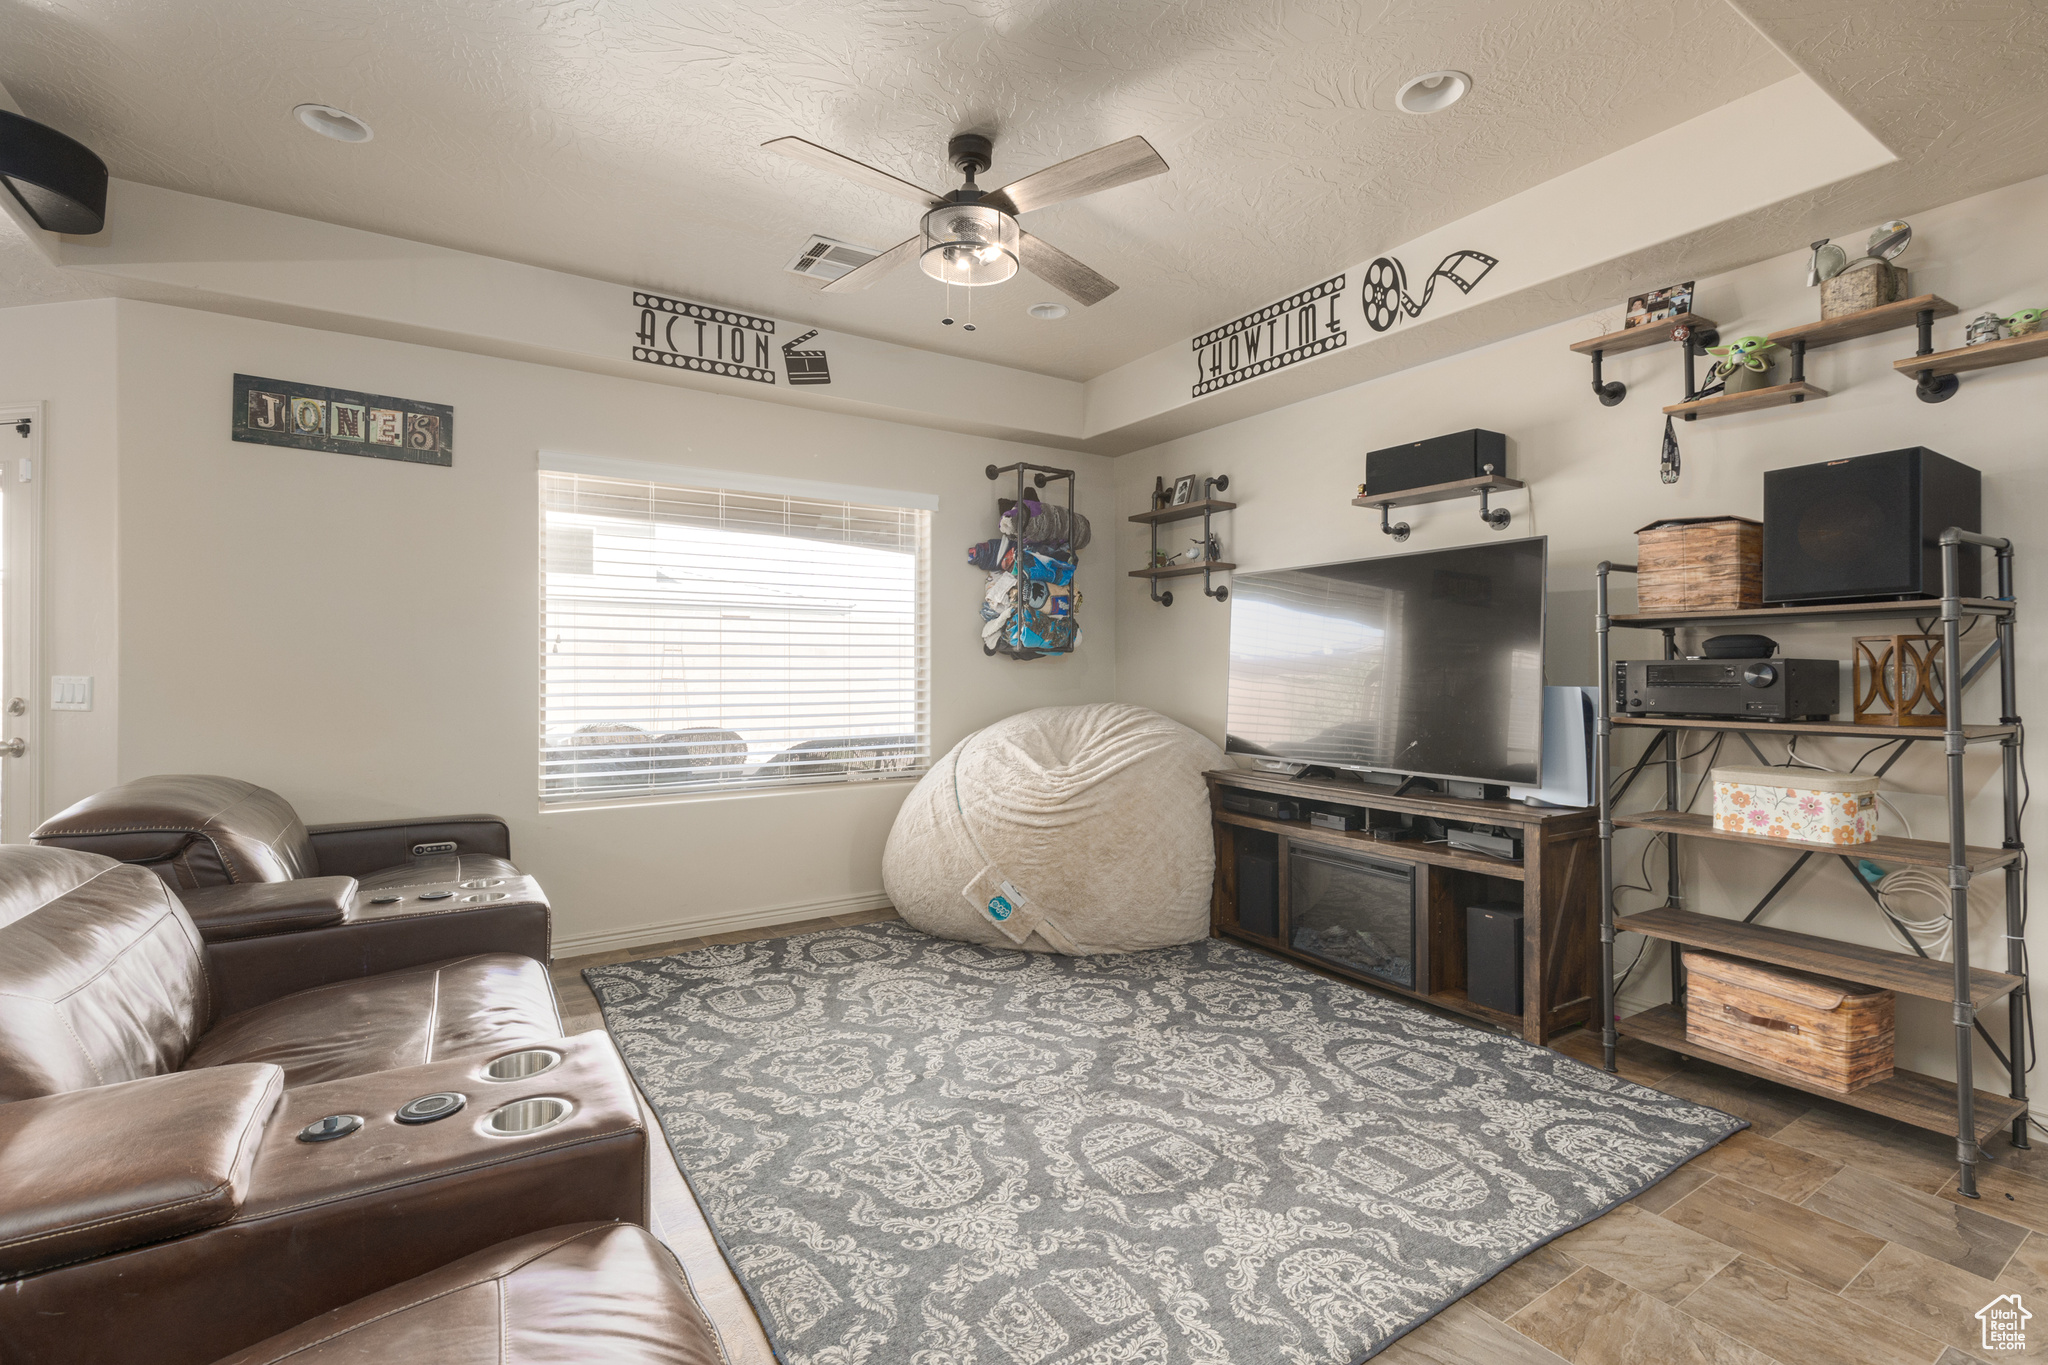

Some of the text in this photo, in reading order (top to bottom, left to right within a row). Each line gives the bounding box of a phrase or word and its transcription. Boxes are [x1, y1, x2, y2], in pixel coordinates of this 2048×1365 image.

[635, 308, 769, 370] ACTION
[1197, 292, 1341, 384] SHOWTIME
[256, 393, 435, 451] JONES
